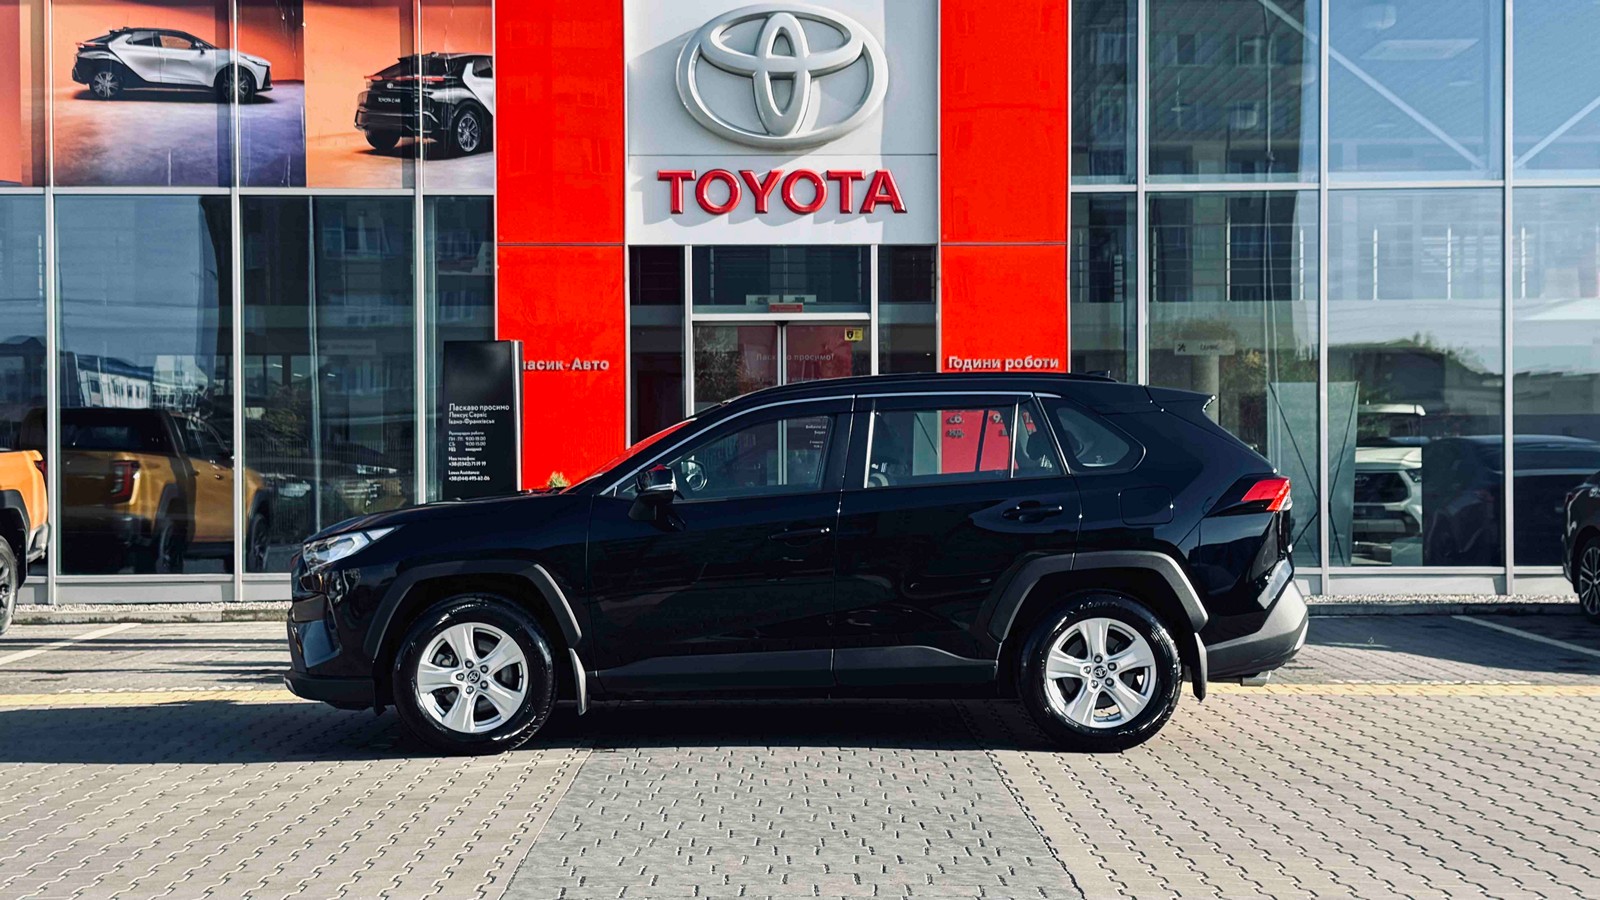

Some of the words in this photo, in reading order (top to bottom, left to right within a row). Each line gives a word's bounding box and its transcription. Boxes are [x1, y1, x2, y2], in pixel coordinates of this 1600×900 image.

[657, 168, 908, 215] TOYOTA
[948, 356, 1001, 371] Години
[1005, 355, 1059, 372] роботи
